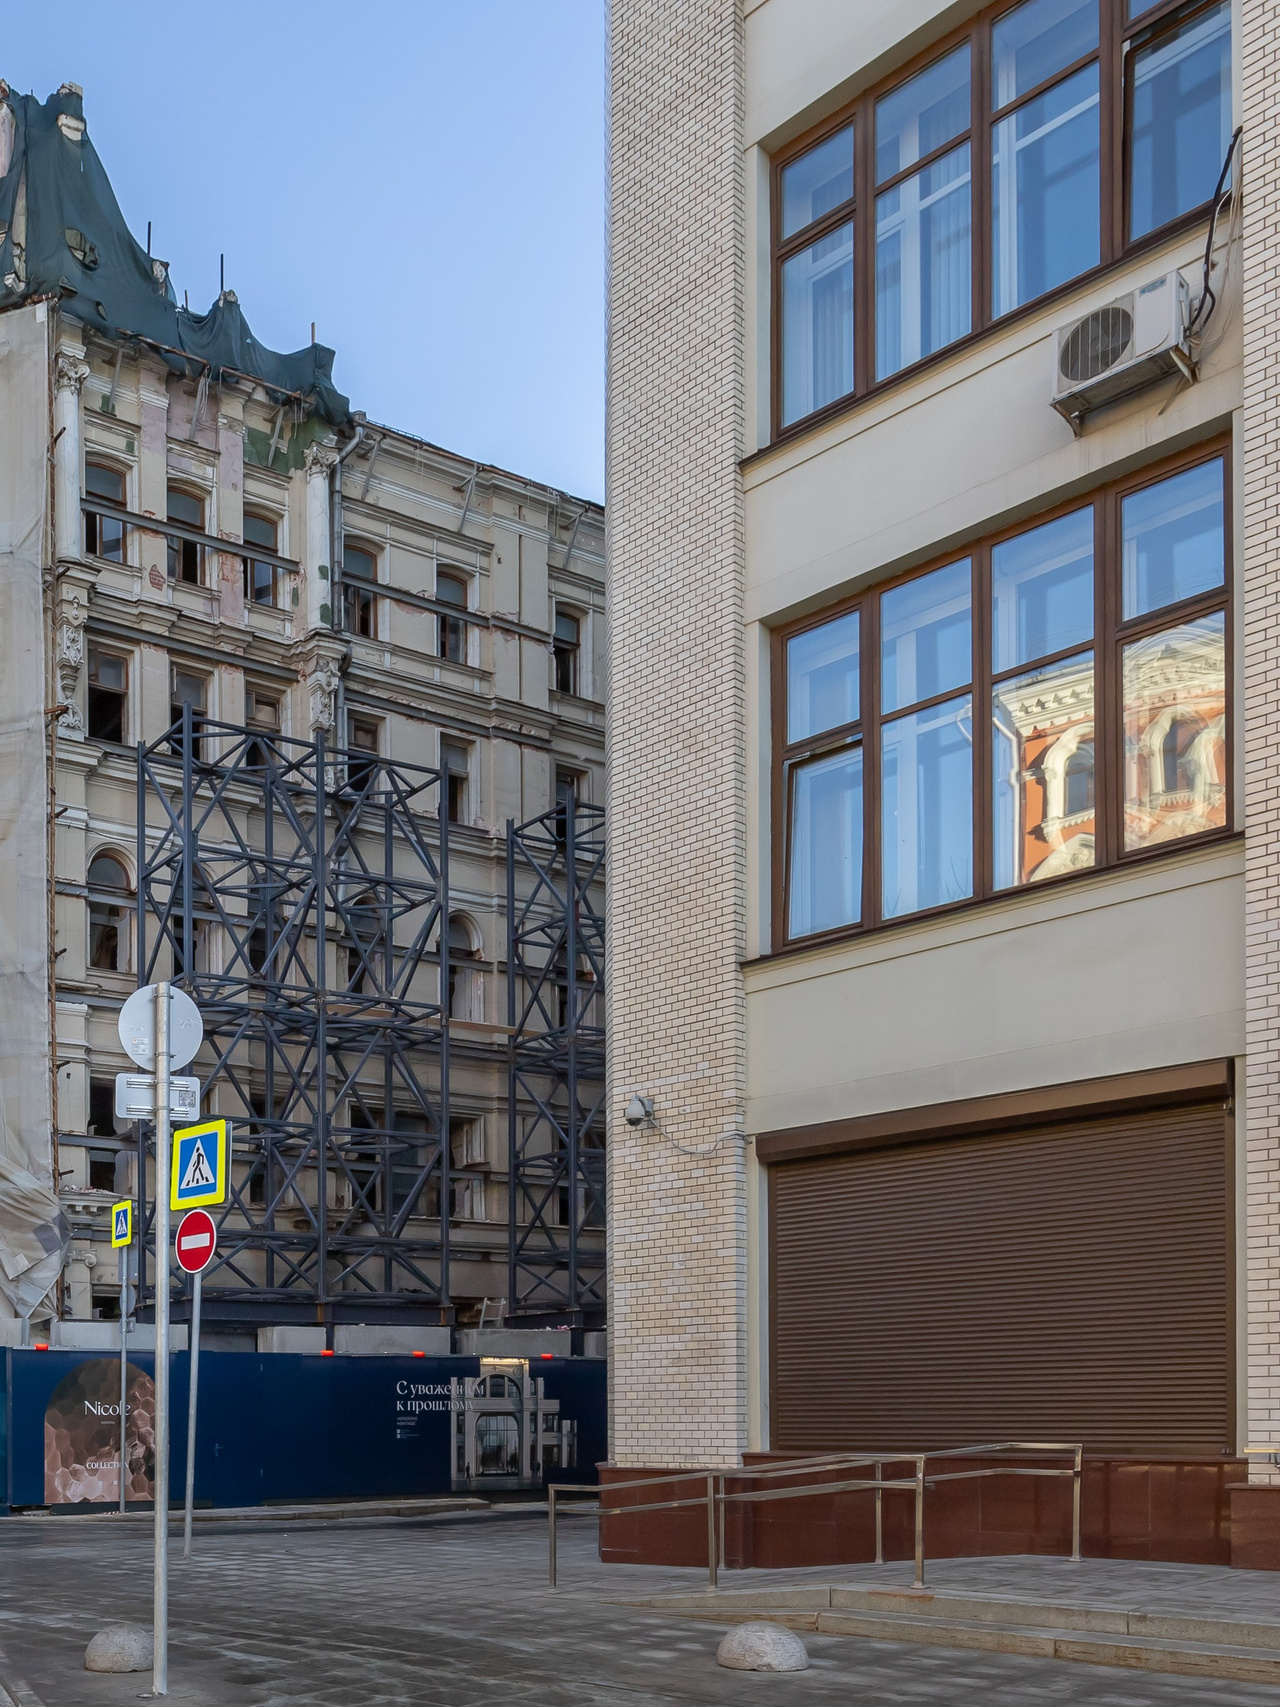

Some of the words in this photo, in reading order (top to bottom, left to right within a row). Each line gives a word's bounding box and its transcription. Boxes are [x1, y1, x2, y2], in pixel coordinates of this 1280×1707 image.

[396, 1380, 408, 1395] С
[84, 1400, 131, 1416] Nicole
[396, 1400, 405, 1411] к
[86, 1461, 129, 1469] COLLECTIN
